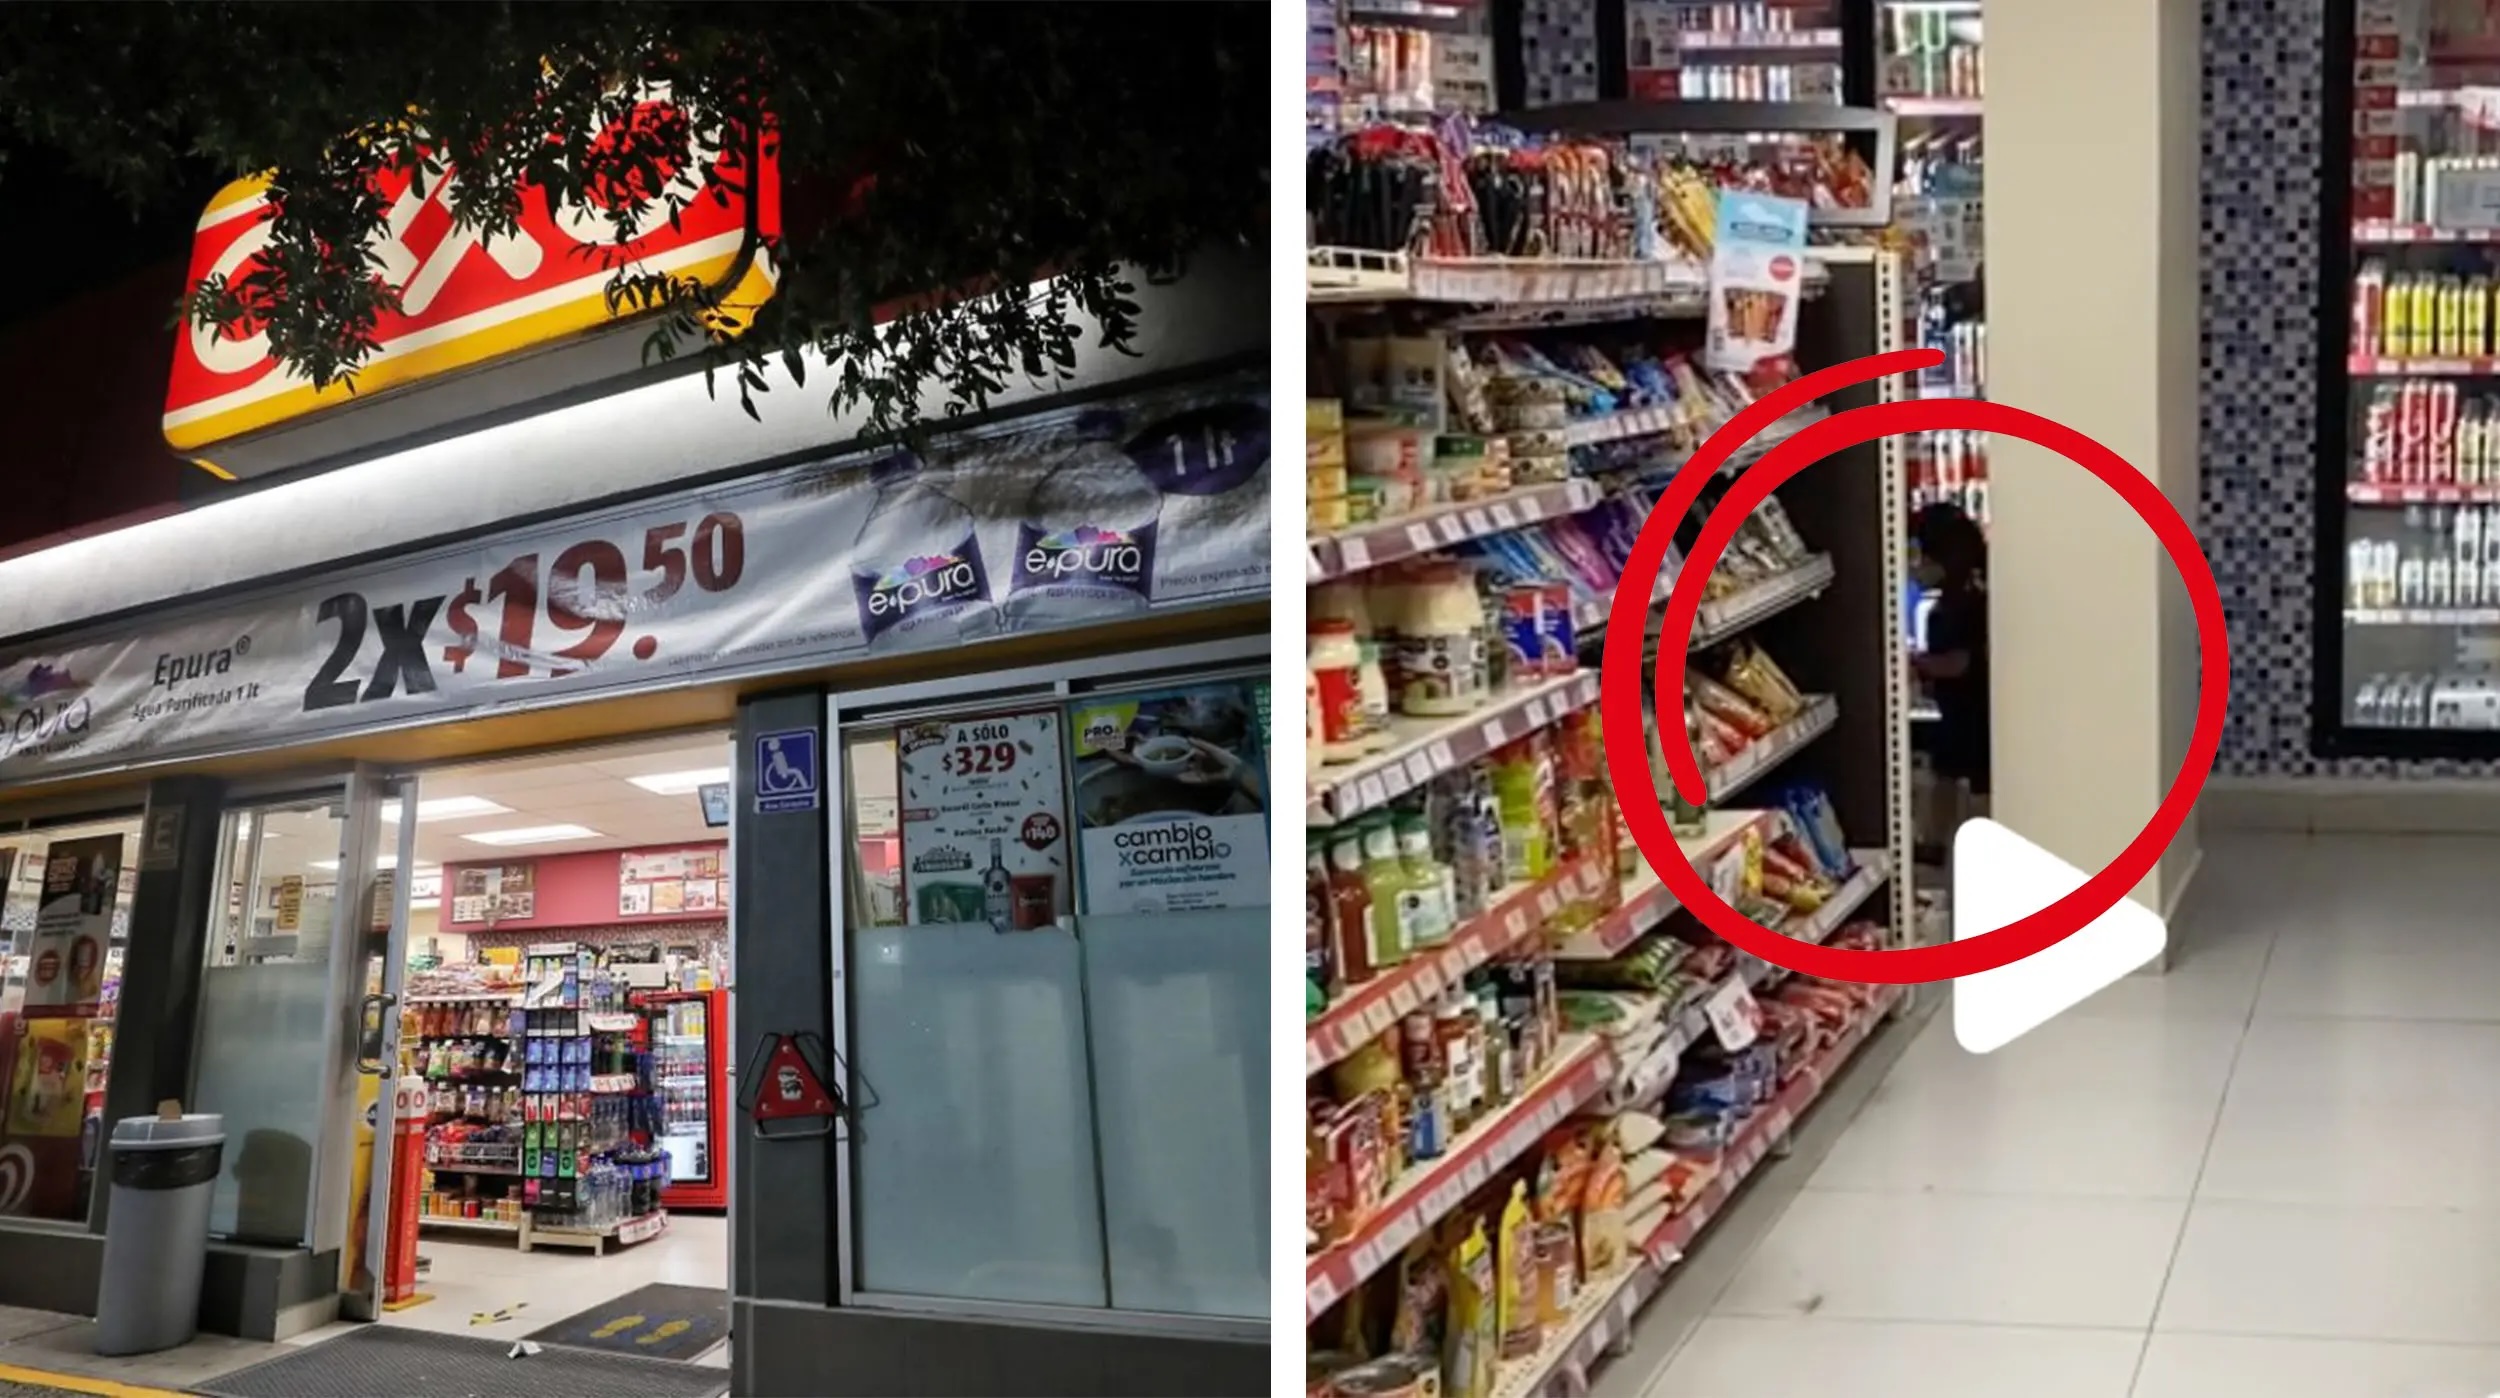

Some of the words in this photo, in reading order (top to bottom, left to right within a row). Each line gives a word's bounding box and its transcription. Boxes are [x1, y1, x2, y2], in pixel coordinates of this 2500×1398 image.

[166, 689, 232, 713] Purificada
[957, 729, 968, 743] A
[972, 723, 1008, 740] SÓLO
[942, 741, 1016, 777] $329
[1114, 822, 1211, 848] cambio
